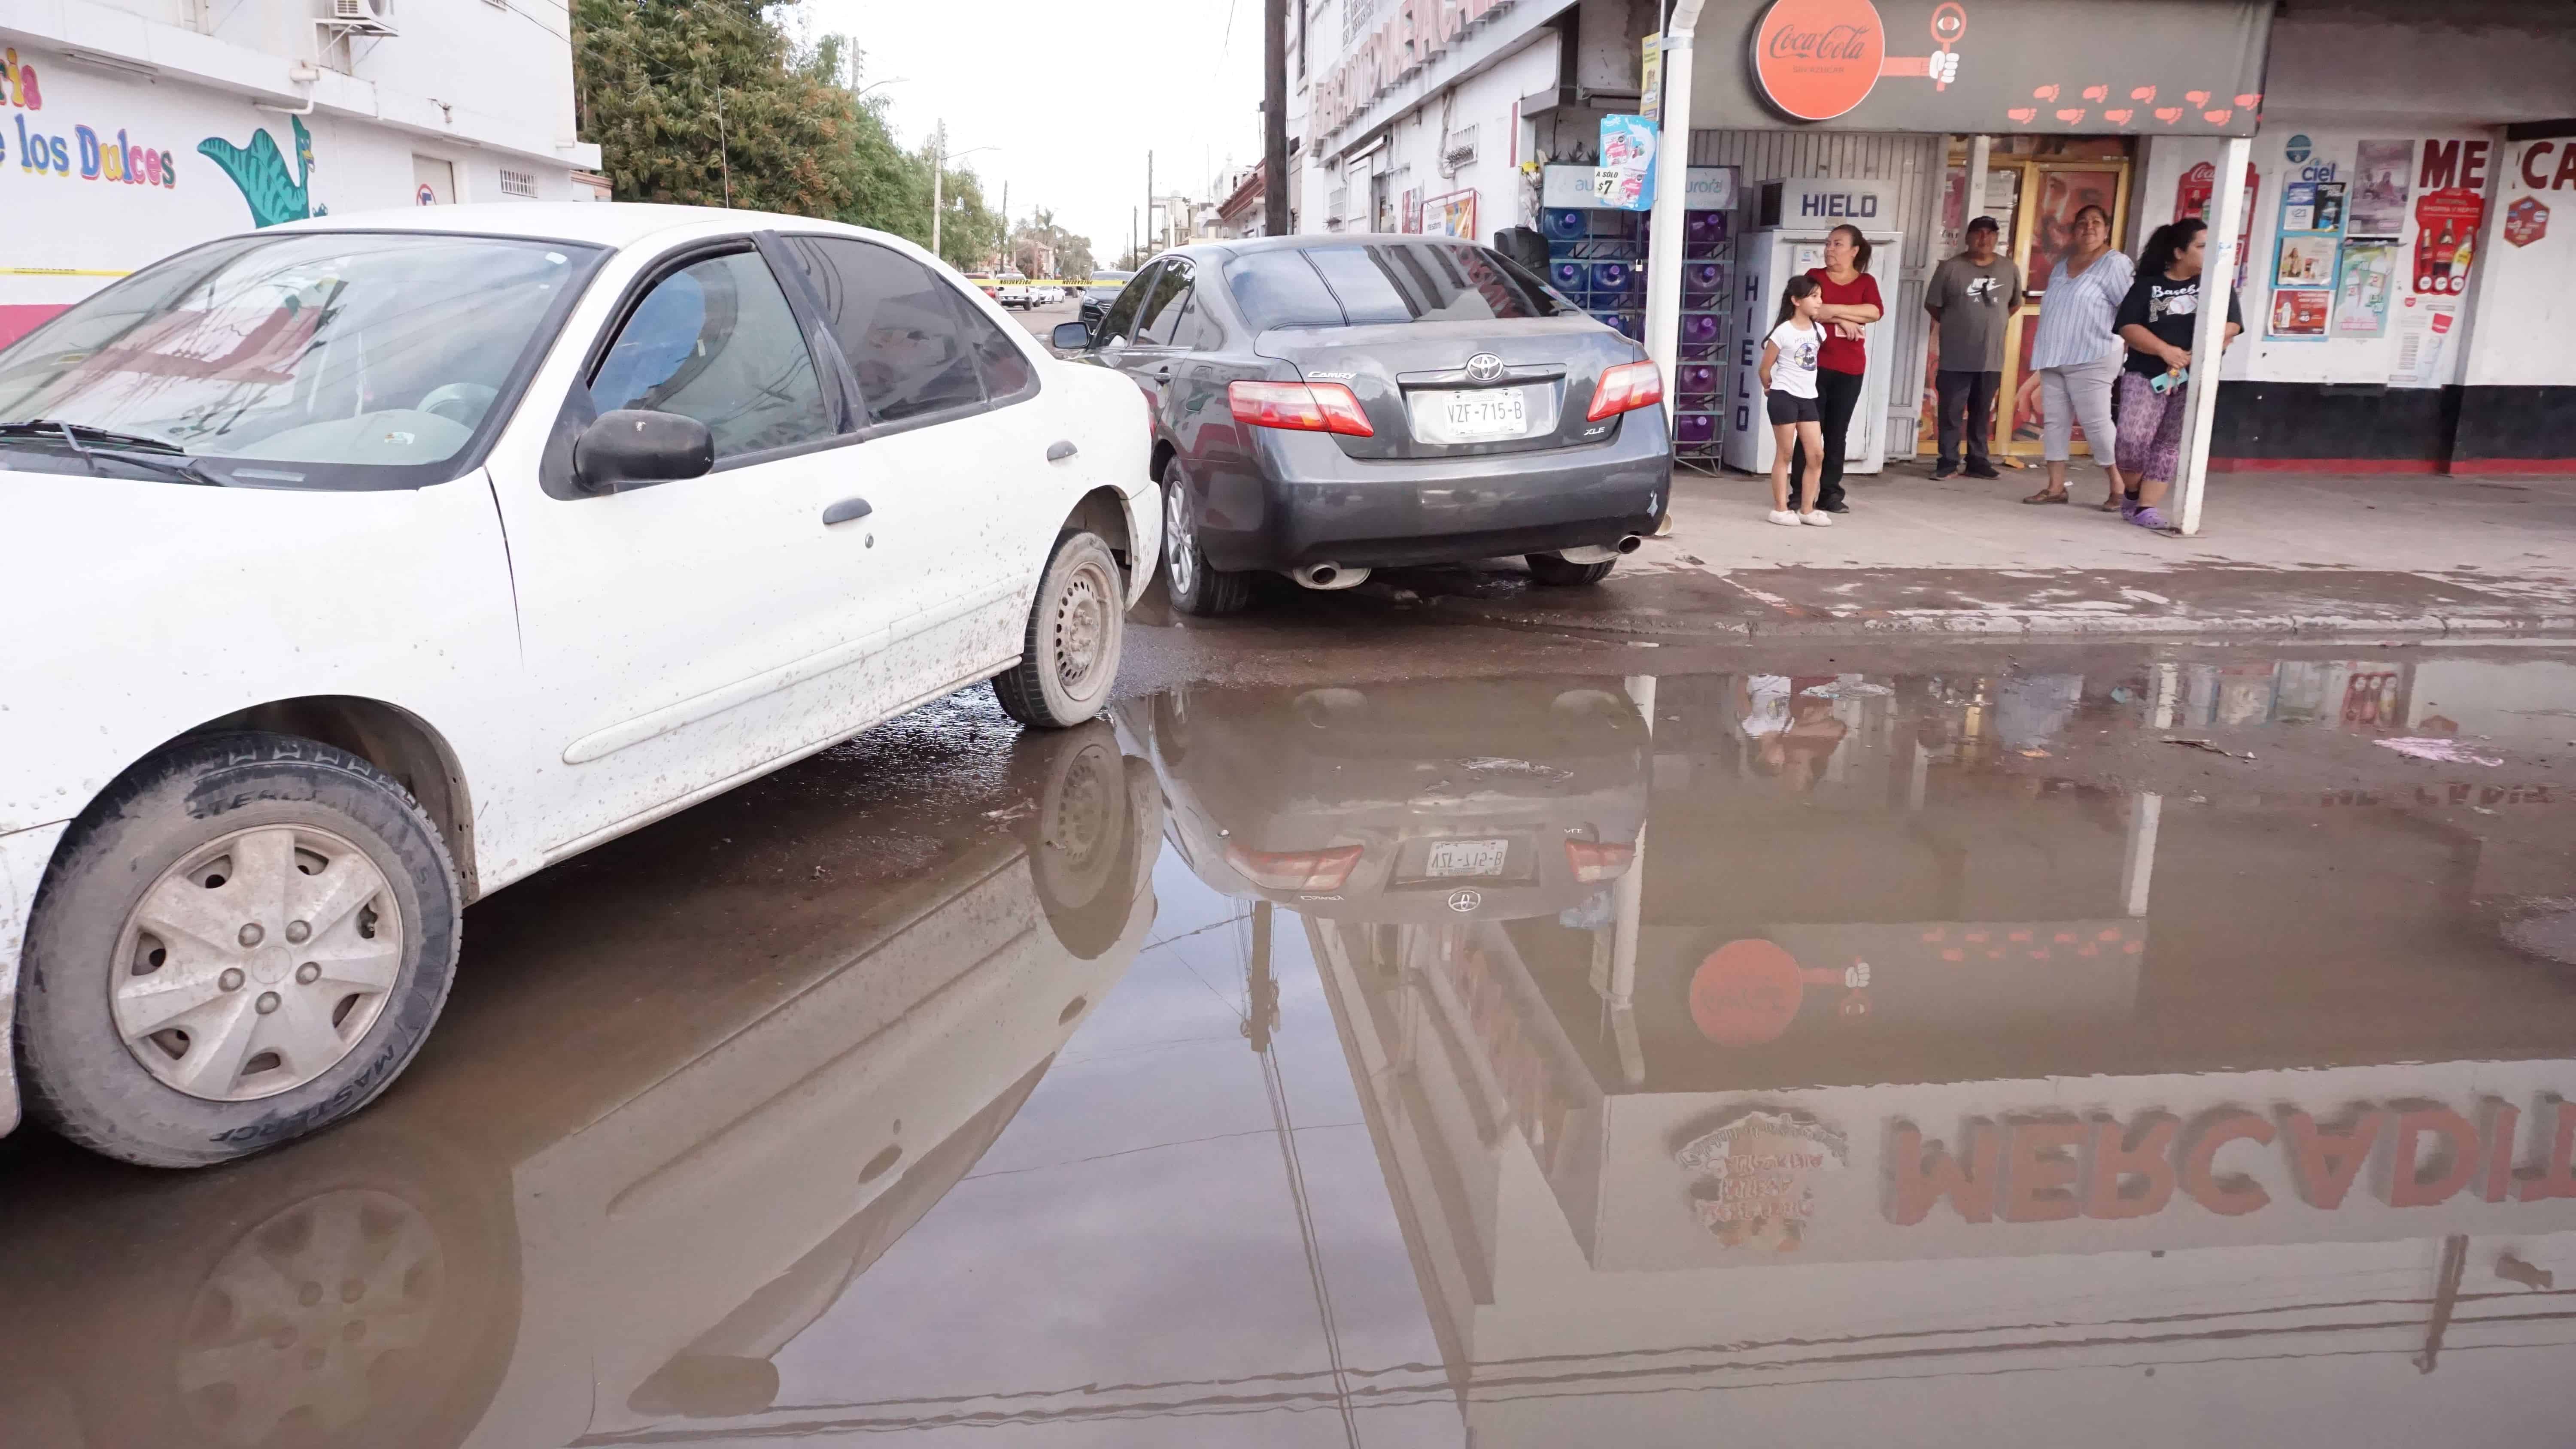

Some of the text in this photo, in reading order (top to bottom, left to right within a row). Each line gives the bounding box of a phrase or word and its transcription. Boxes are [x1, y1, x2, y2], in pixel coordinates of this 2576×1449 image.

[1769, 24, 1872, 60] Coca-Cola
[15, 113, 70, 177] los
[75, 124, 176, 189] Dulces
[2302, 163, 2336, 182] ciel
[1685, 178, 1722, 194] urora
[1802, 194, 1877, 218] HIELO
[2152, 285, 2200, 298] Baseb
[1736, 276, 1758, 432] HIELO
[1447, 401, 1522, 423] VZF-715-B
[1584, 426, 1605, 436] XLE
